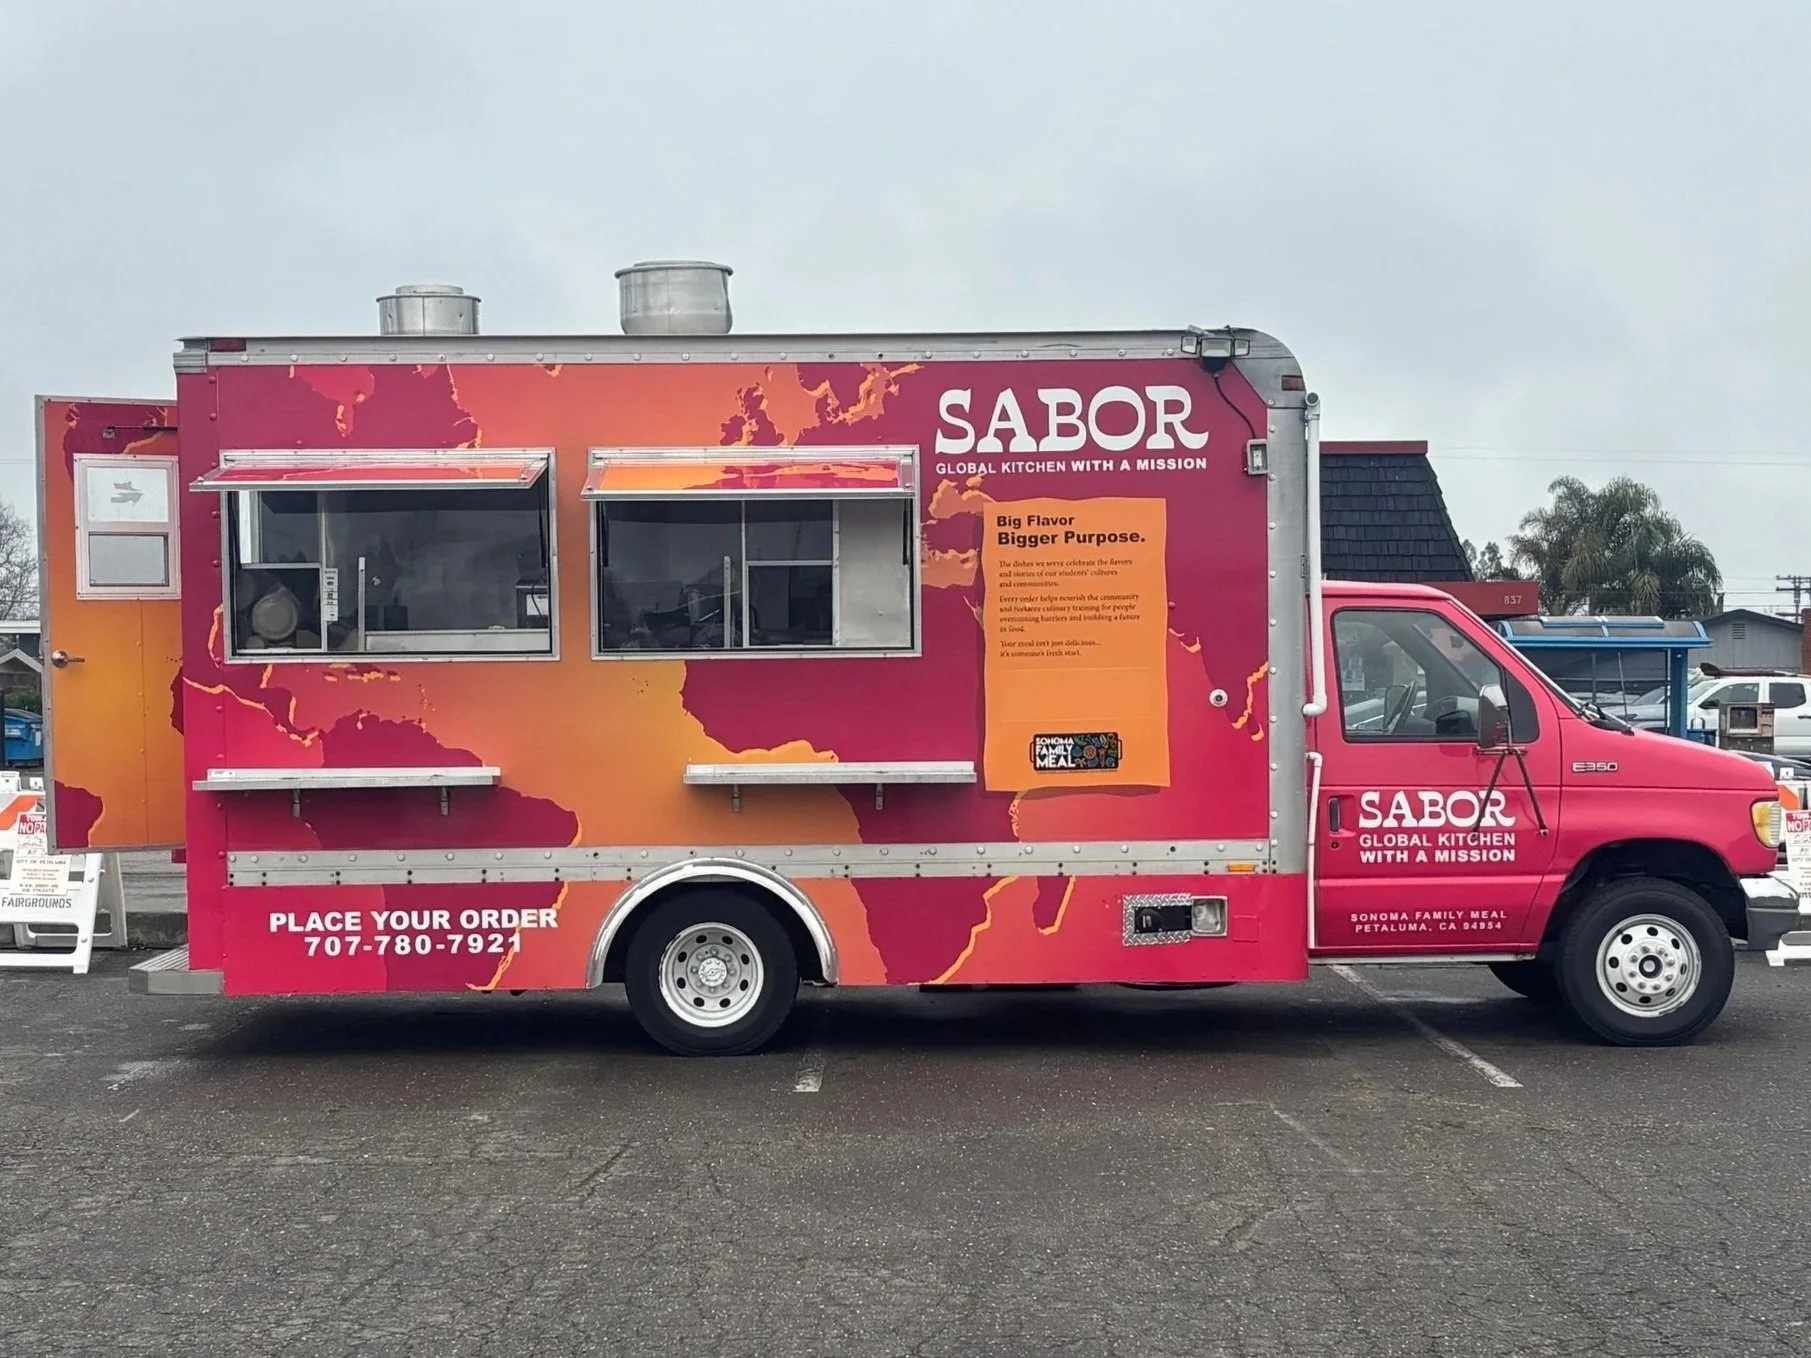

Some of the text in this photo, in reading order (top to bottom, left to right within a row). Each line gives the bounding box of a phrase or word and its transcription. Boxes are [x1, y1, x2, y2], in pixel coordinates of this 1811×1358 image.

[935, 385, 1209, 454] SABOR
[936, 458, 1207, 475] GLOBAL KITCHEN WITH A MISSION
[997, 515, 1075, 529] Big Flavor
[998, 530, 1146, 547] Bigger Purpose.
[1000, 559, 1011, 568] The
[1013, 559, 1034, 568] dishes
[1065, 558, 1095, 567] celebrate
[1096, 558, 1108, 566] the
[1110, 557, 1133, 566] flavors
[1013, 569, 1035, 577] stories
[1036, 569, 1044, 577] of
[1090, 568, 1118, 576] cultures
[999, 580, 1012, 588] and
[1000, 592, 1139, 603] Every order helps nourish the community
[999, 605, 1012, 613] and
[1042, 604, 1070, 613] culinary
[1072, 603, 1100, 613] training
[1102, 602, 1112, 611] for
[1113, 602, 1136, 612] people
[999, 616, 1040, 624] overcoming
[1040, 613, 1068, 622] barriers
[1069, 613, 1082, 621] and
[1083, 612, 1112, 622] building
[1120, 612, 1140, 621] future
[1000, 625, 1007, 633] in
[1018, 639, 1035, 647] meal
[1051, 639, 1064, 648] just
[1046, 648, 1063, 657] fresh
[1036, 737, 1074, 746] SONOMA
[1036, 745, 1073, 755] FAMILY
[1036, 755, 1076, 768] MEAL
[1572, 762, 1618, 772] E350
[1359, 790, 1516, 828] SABOR
[1359, 832, 1515, 847] GLOBAL KITCHEN
[1360, 849, 1515, 863] WITH A MISSION
[1, 896, 72, 909] FAIRGROUNDS
[269, 908, 558, 932] PLACE YOUR ORDER
[1350, 910, 1507, 922] SONOMA FAMILY MEAL
[1439, 922, 1457, 931] CA
[304, 933, 521, 956] 707-780-7921
